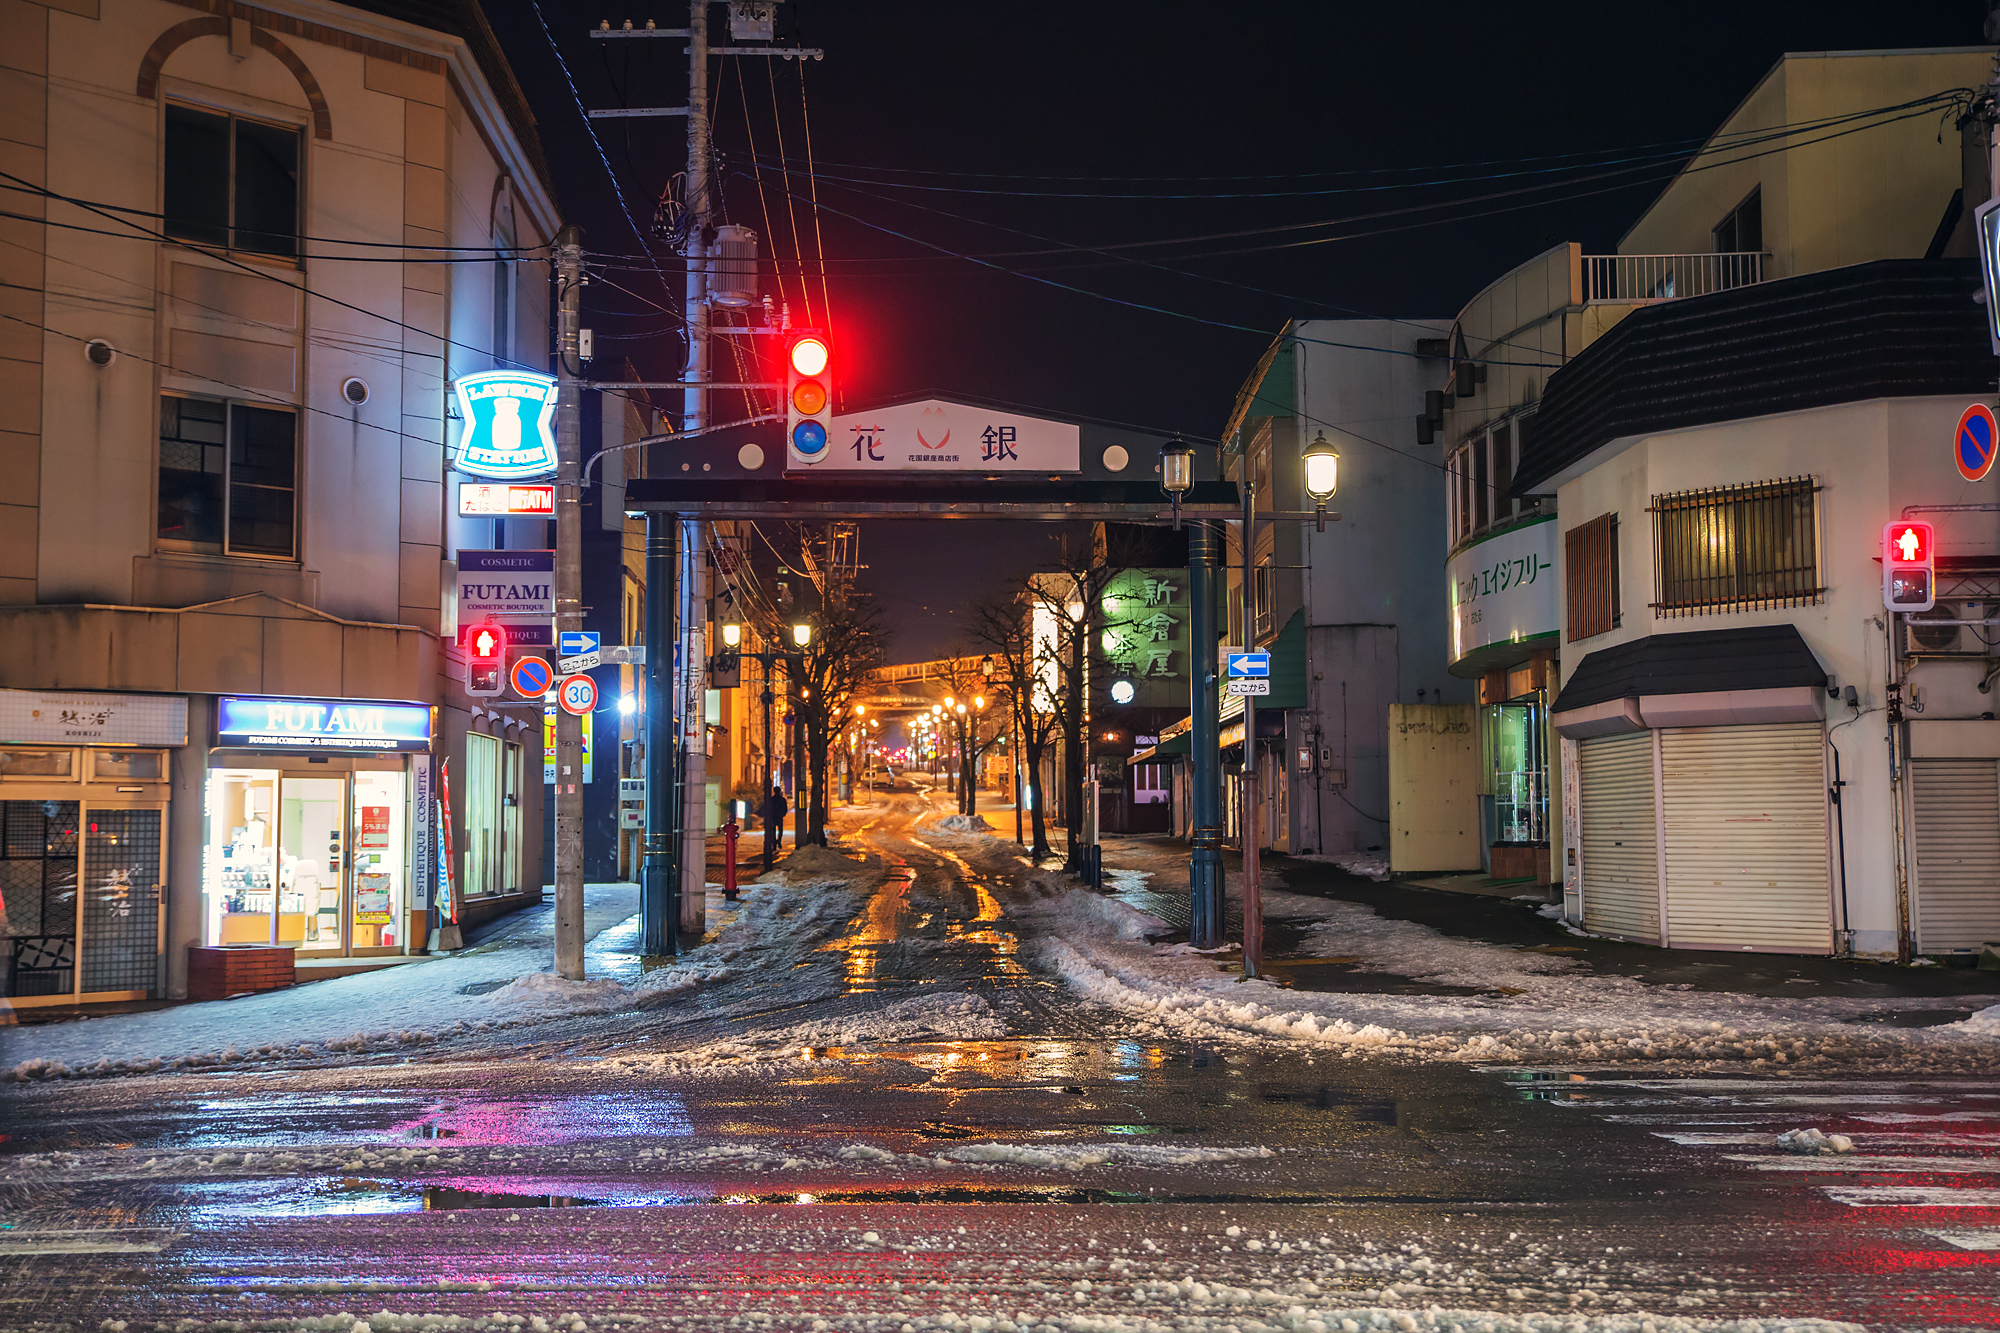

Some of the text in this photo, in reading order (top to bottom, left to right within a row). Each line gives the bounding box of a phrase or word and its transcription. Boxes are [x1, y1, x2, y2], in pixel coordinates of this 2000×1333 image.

[850, 424, 1018, 461] 花 銀
[479, 486, 490, 498] 酒
[481, 558, 535, 566] COSMETIC
[1482, 553, 1551, 596] エイジフリー
[462, 584, 550, 600] FUTAMI
[505, 632, 540, 640] TIQUE
[563, 656, 599, 671] ここから
[569, 686, 591, 704] 30
[1231, 683, 1267, 692] ここから
[265, 704, 385, 733] FUTAMI
[249, 736, 278, 744] FUTAMI
[417, 767, 427, 897] ESTHETIQUE COSMETIC
